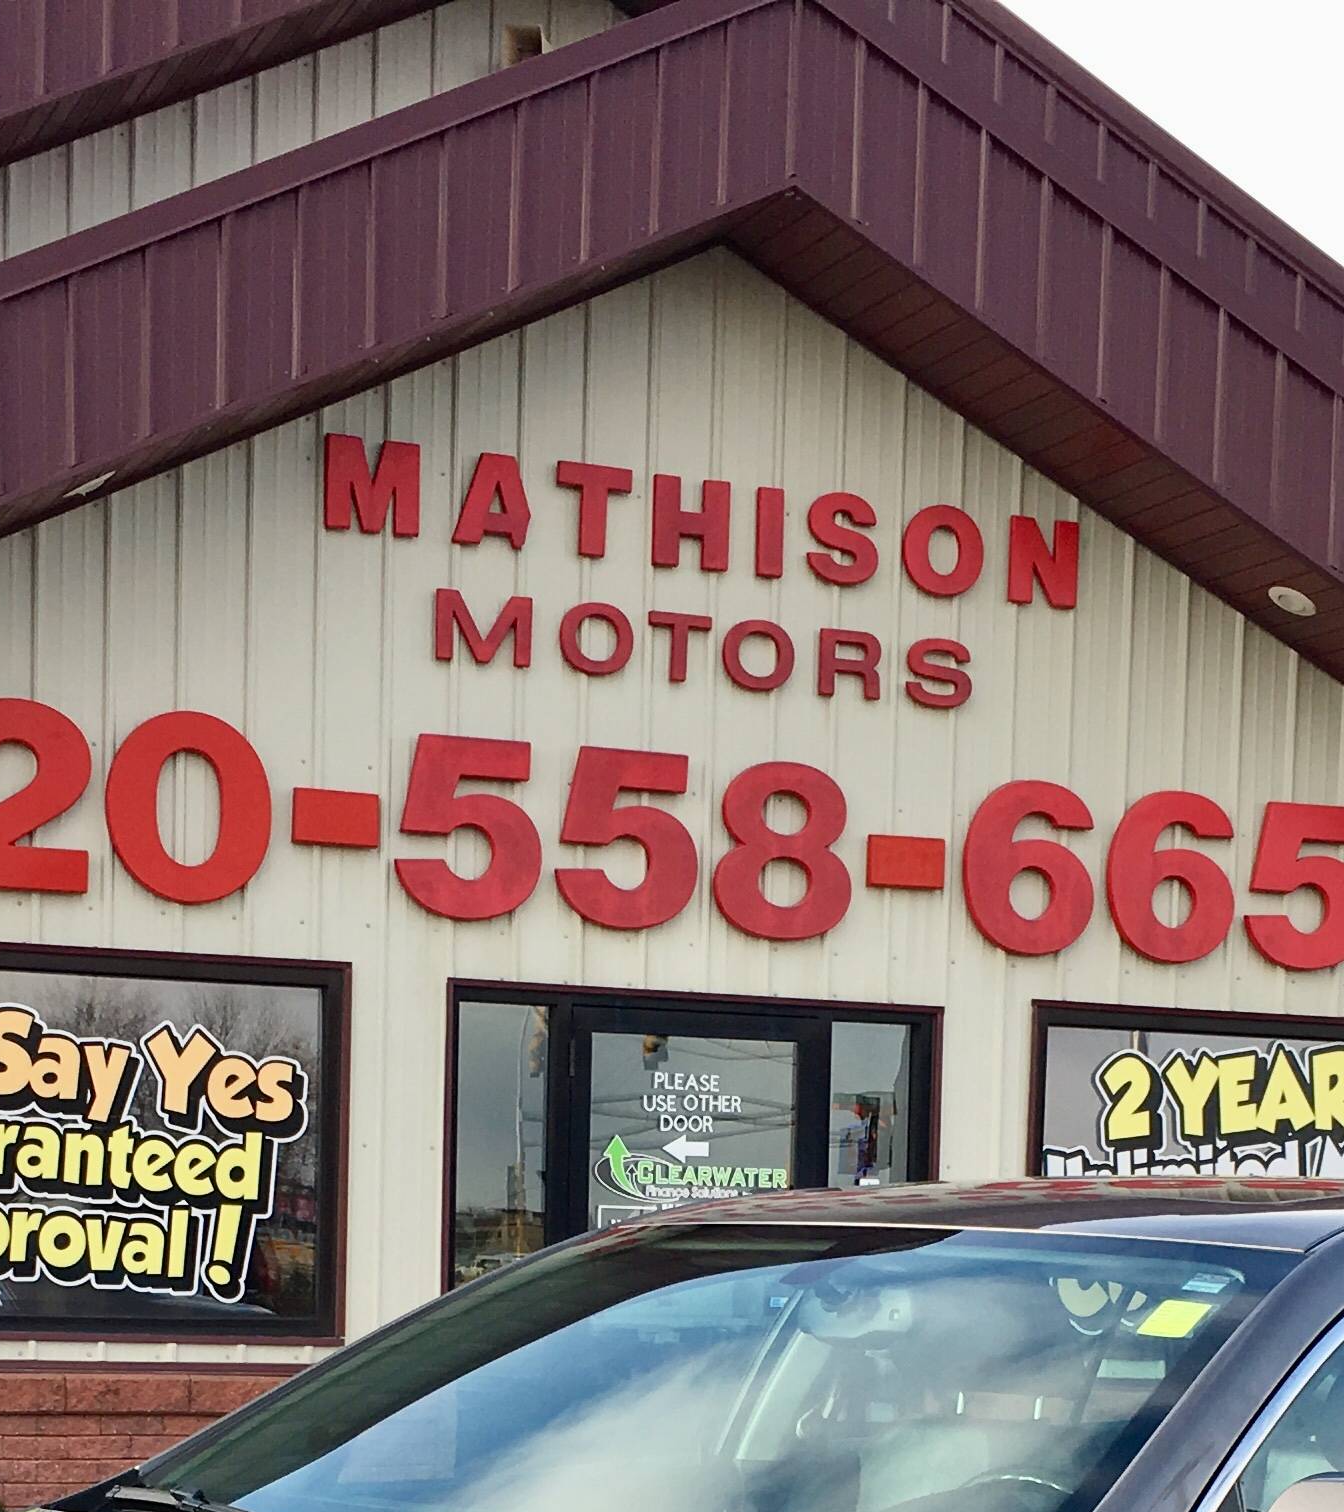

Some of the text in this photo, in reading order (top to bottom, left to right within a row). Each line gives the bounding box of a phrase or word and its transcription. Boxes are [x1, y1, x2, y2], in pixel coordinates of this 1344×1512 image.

[323, 432, 1080, 611] MATHISON
[433, 587, 973, 710] MOTORS
[145, 1025, 301, 1125] Yes
[653, 1071, 721, 1093] PLEASE
[643, 1094, 742, 1113] USE OTHER
[1102, 1055, 1152, 1142] 2
[659, 1114, 714, 1133] DOOR
[637, 1160, 788, 1189] CLEARWATER
[645, 1184, 690, 1199] Finance
